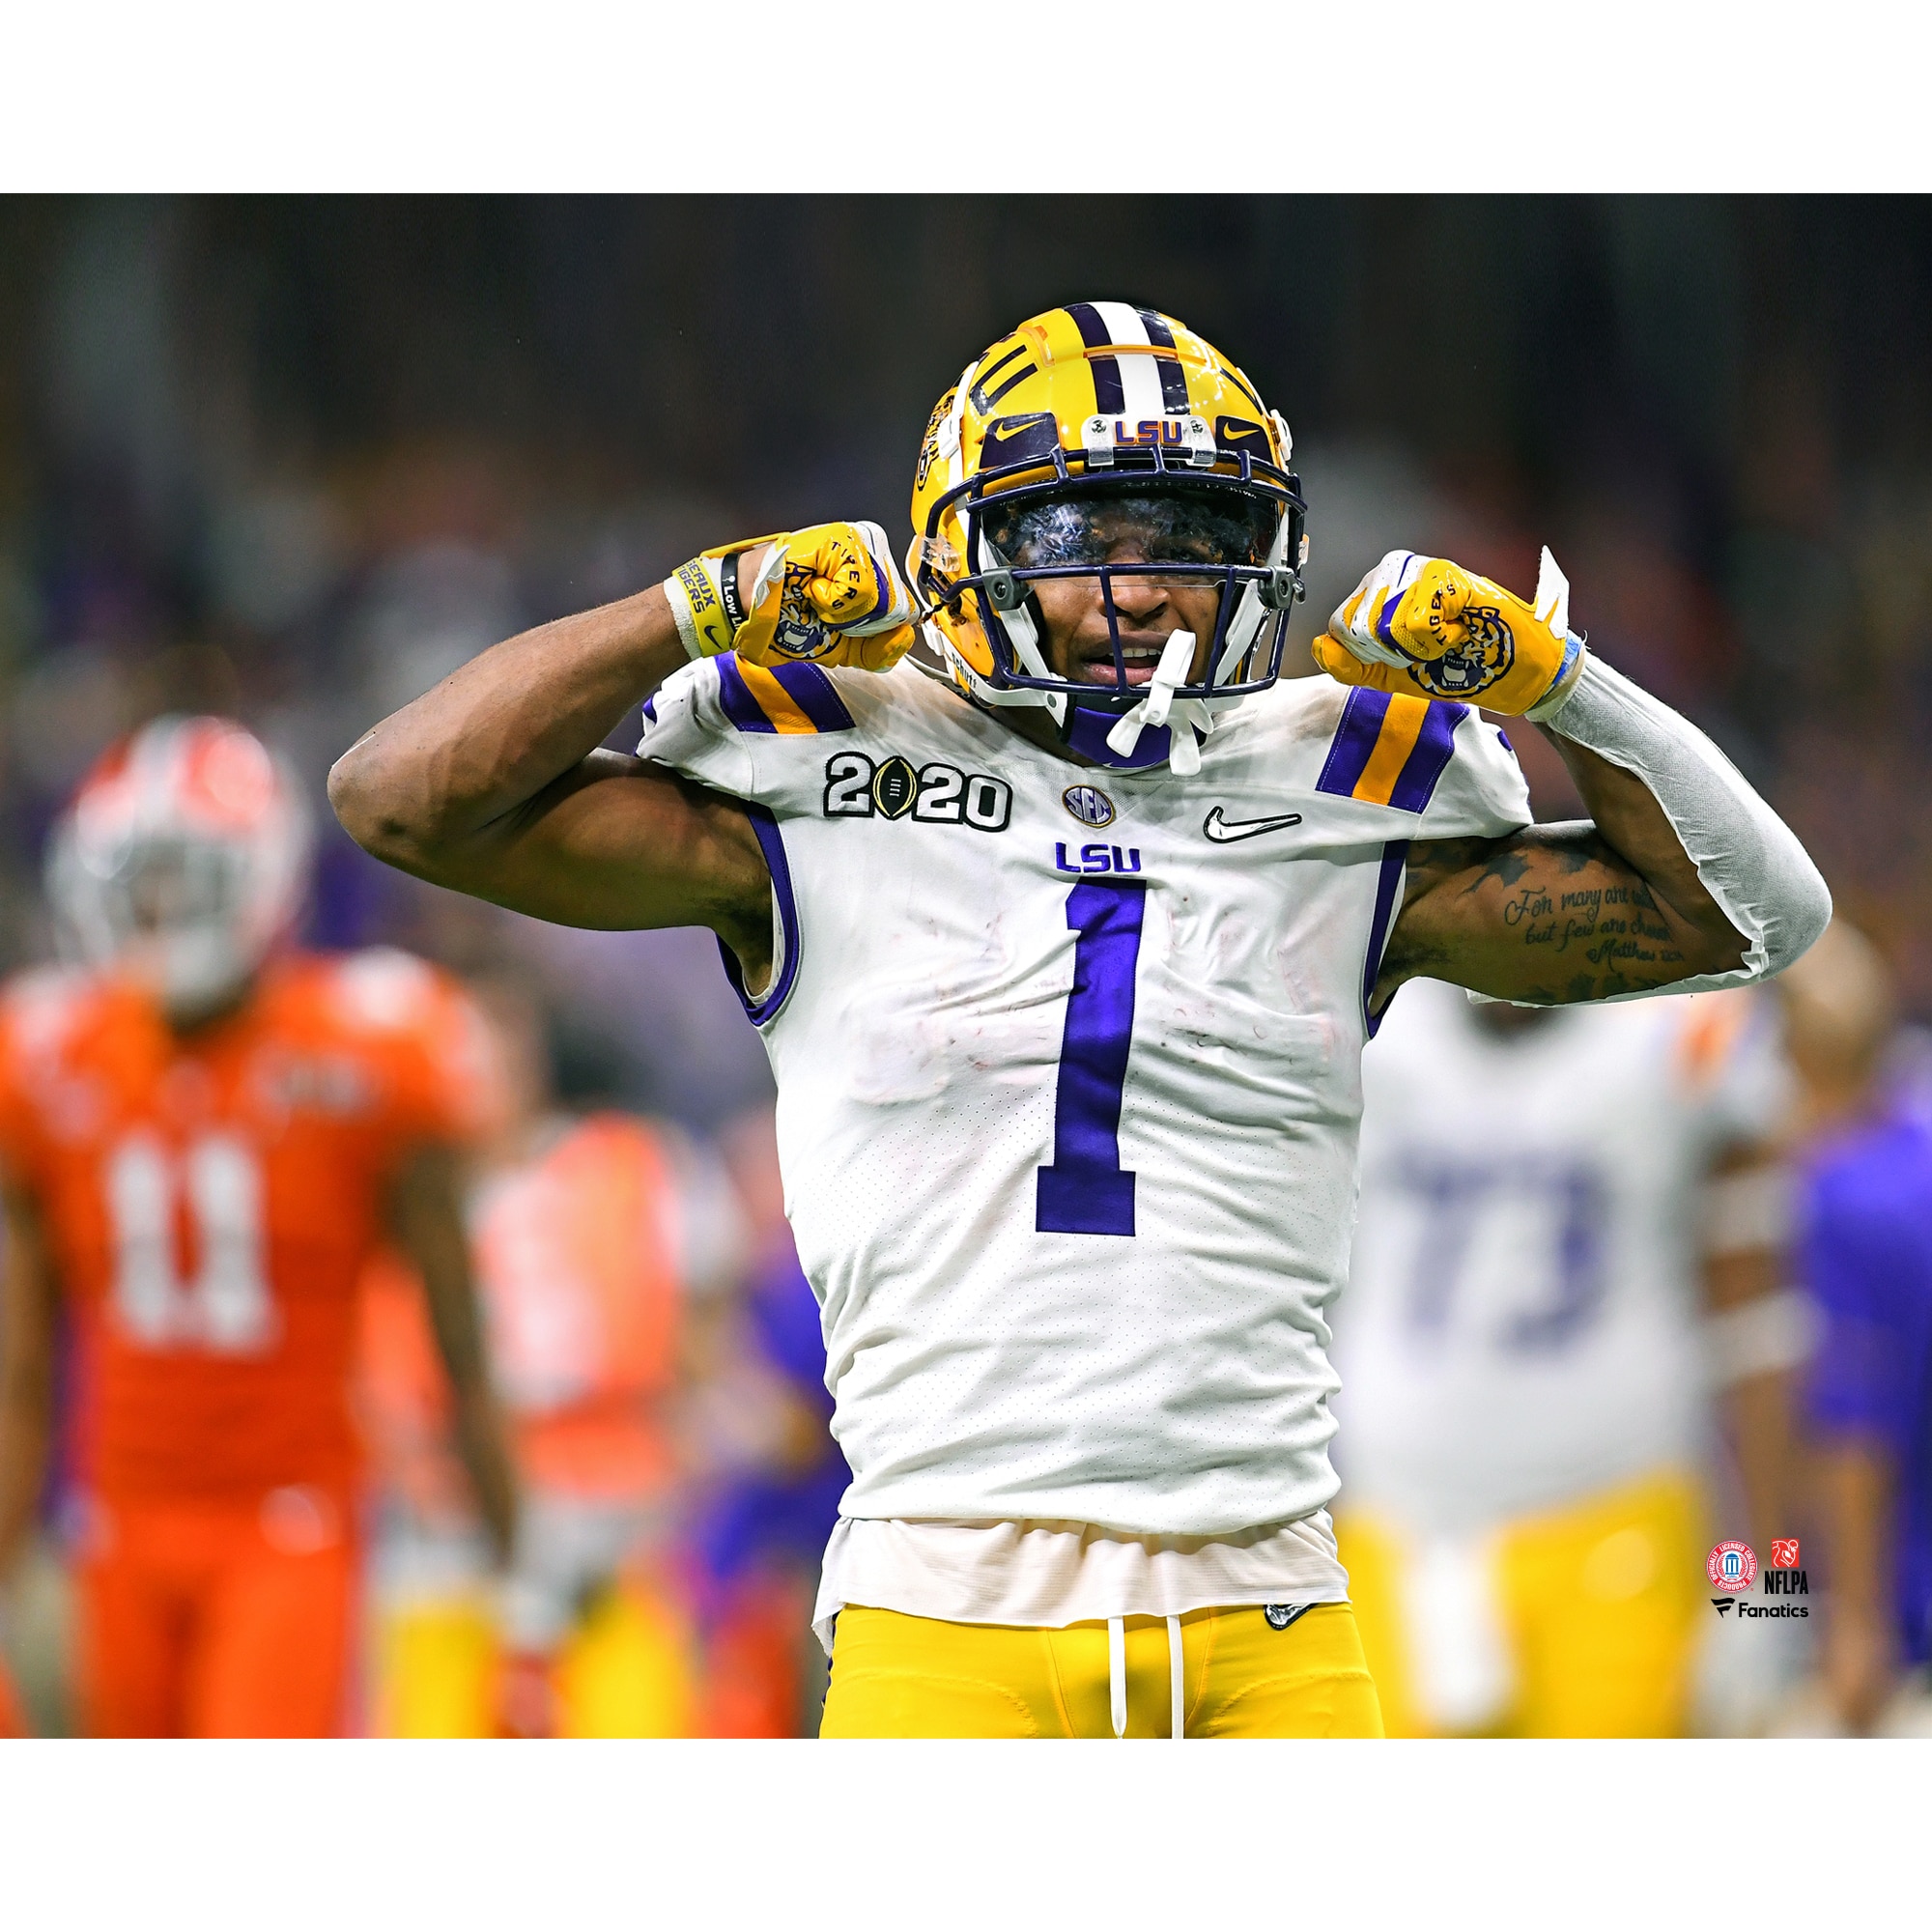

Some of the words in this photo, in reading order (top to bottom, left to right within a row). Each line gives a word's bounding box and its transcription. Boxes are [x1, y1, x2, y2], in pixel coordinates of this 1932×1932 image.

[1114, 419, 1184, 445] LSU
[677, 565, 706, 614] IGERS
[831, 540, 860, 611] TIGERS
[1065, 784, 1114, 824] SEC
[1055, 841, 1142, 873] LSU
[1560, 887, 1603, 923] many
[1524, 921, 1557, 946] but
[1554, 919, 1595, 952] few
[1036, 876, 1147, 1236] 1
